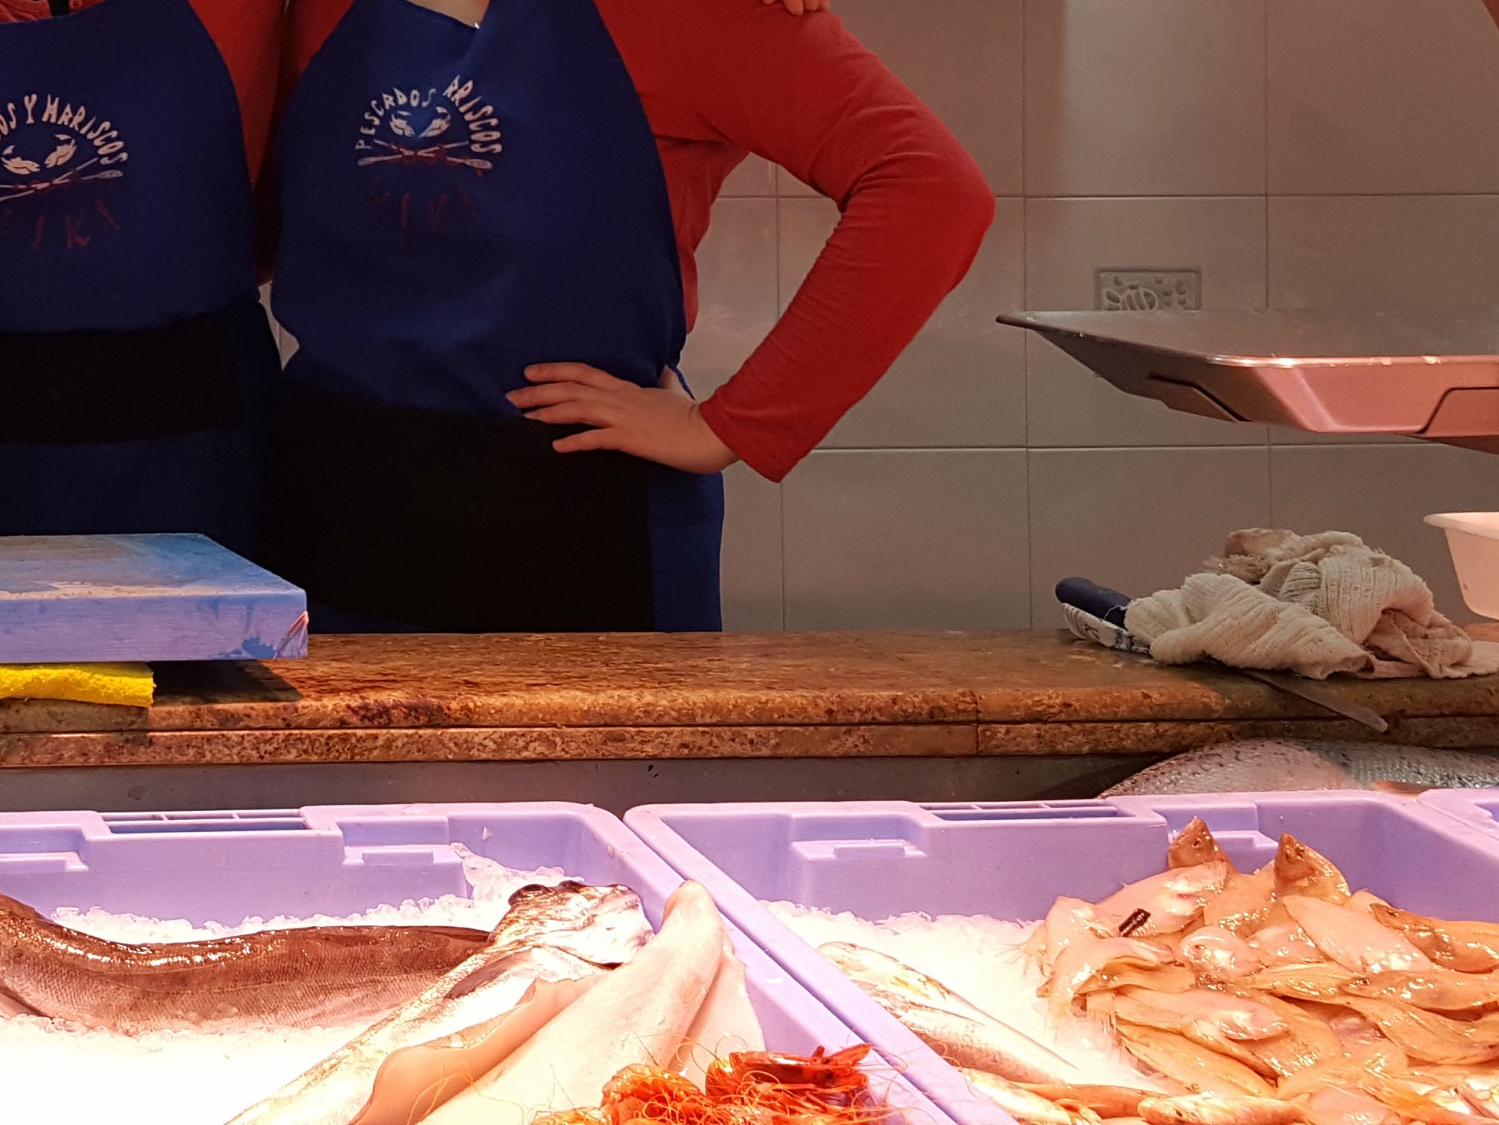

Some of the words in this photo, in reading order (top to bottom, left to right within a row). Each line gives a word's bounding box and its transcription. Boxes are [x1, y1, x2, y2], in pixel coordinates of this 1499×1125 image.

[24, 93, 38, 124] Y
[42, 94, 129, 165] MARISCOS
[354, 87, 436, 151] PESCADOS
[442, 74, 503, 154] ARISCOS
